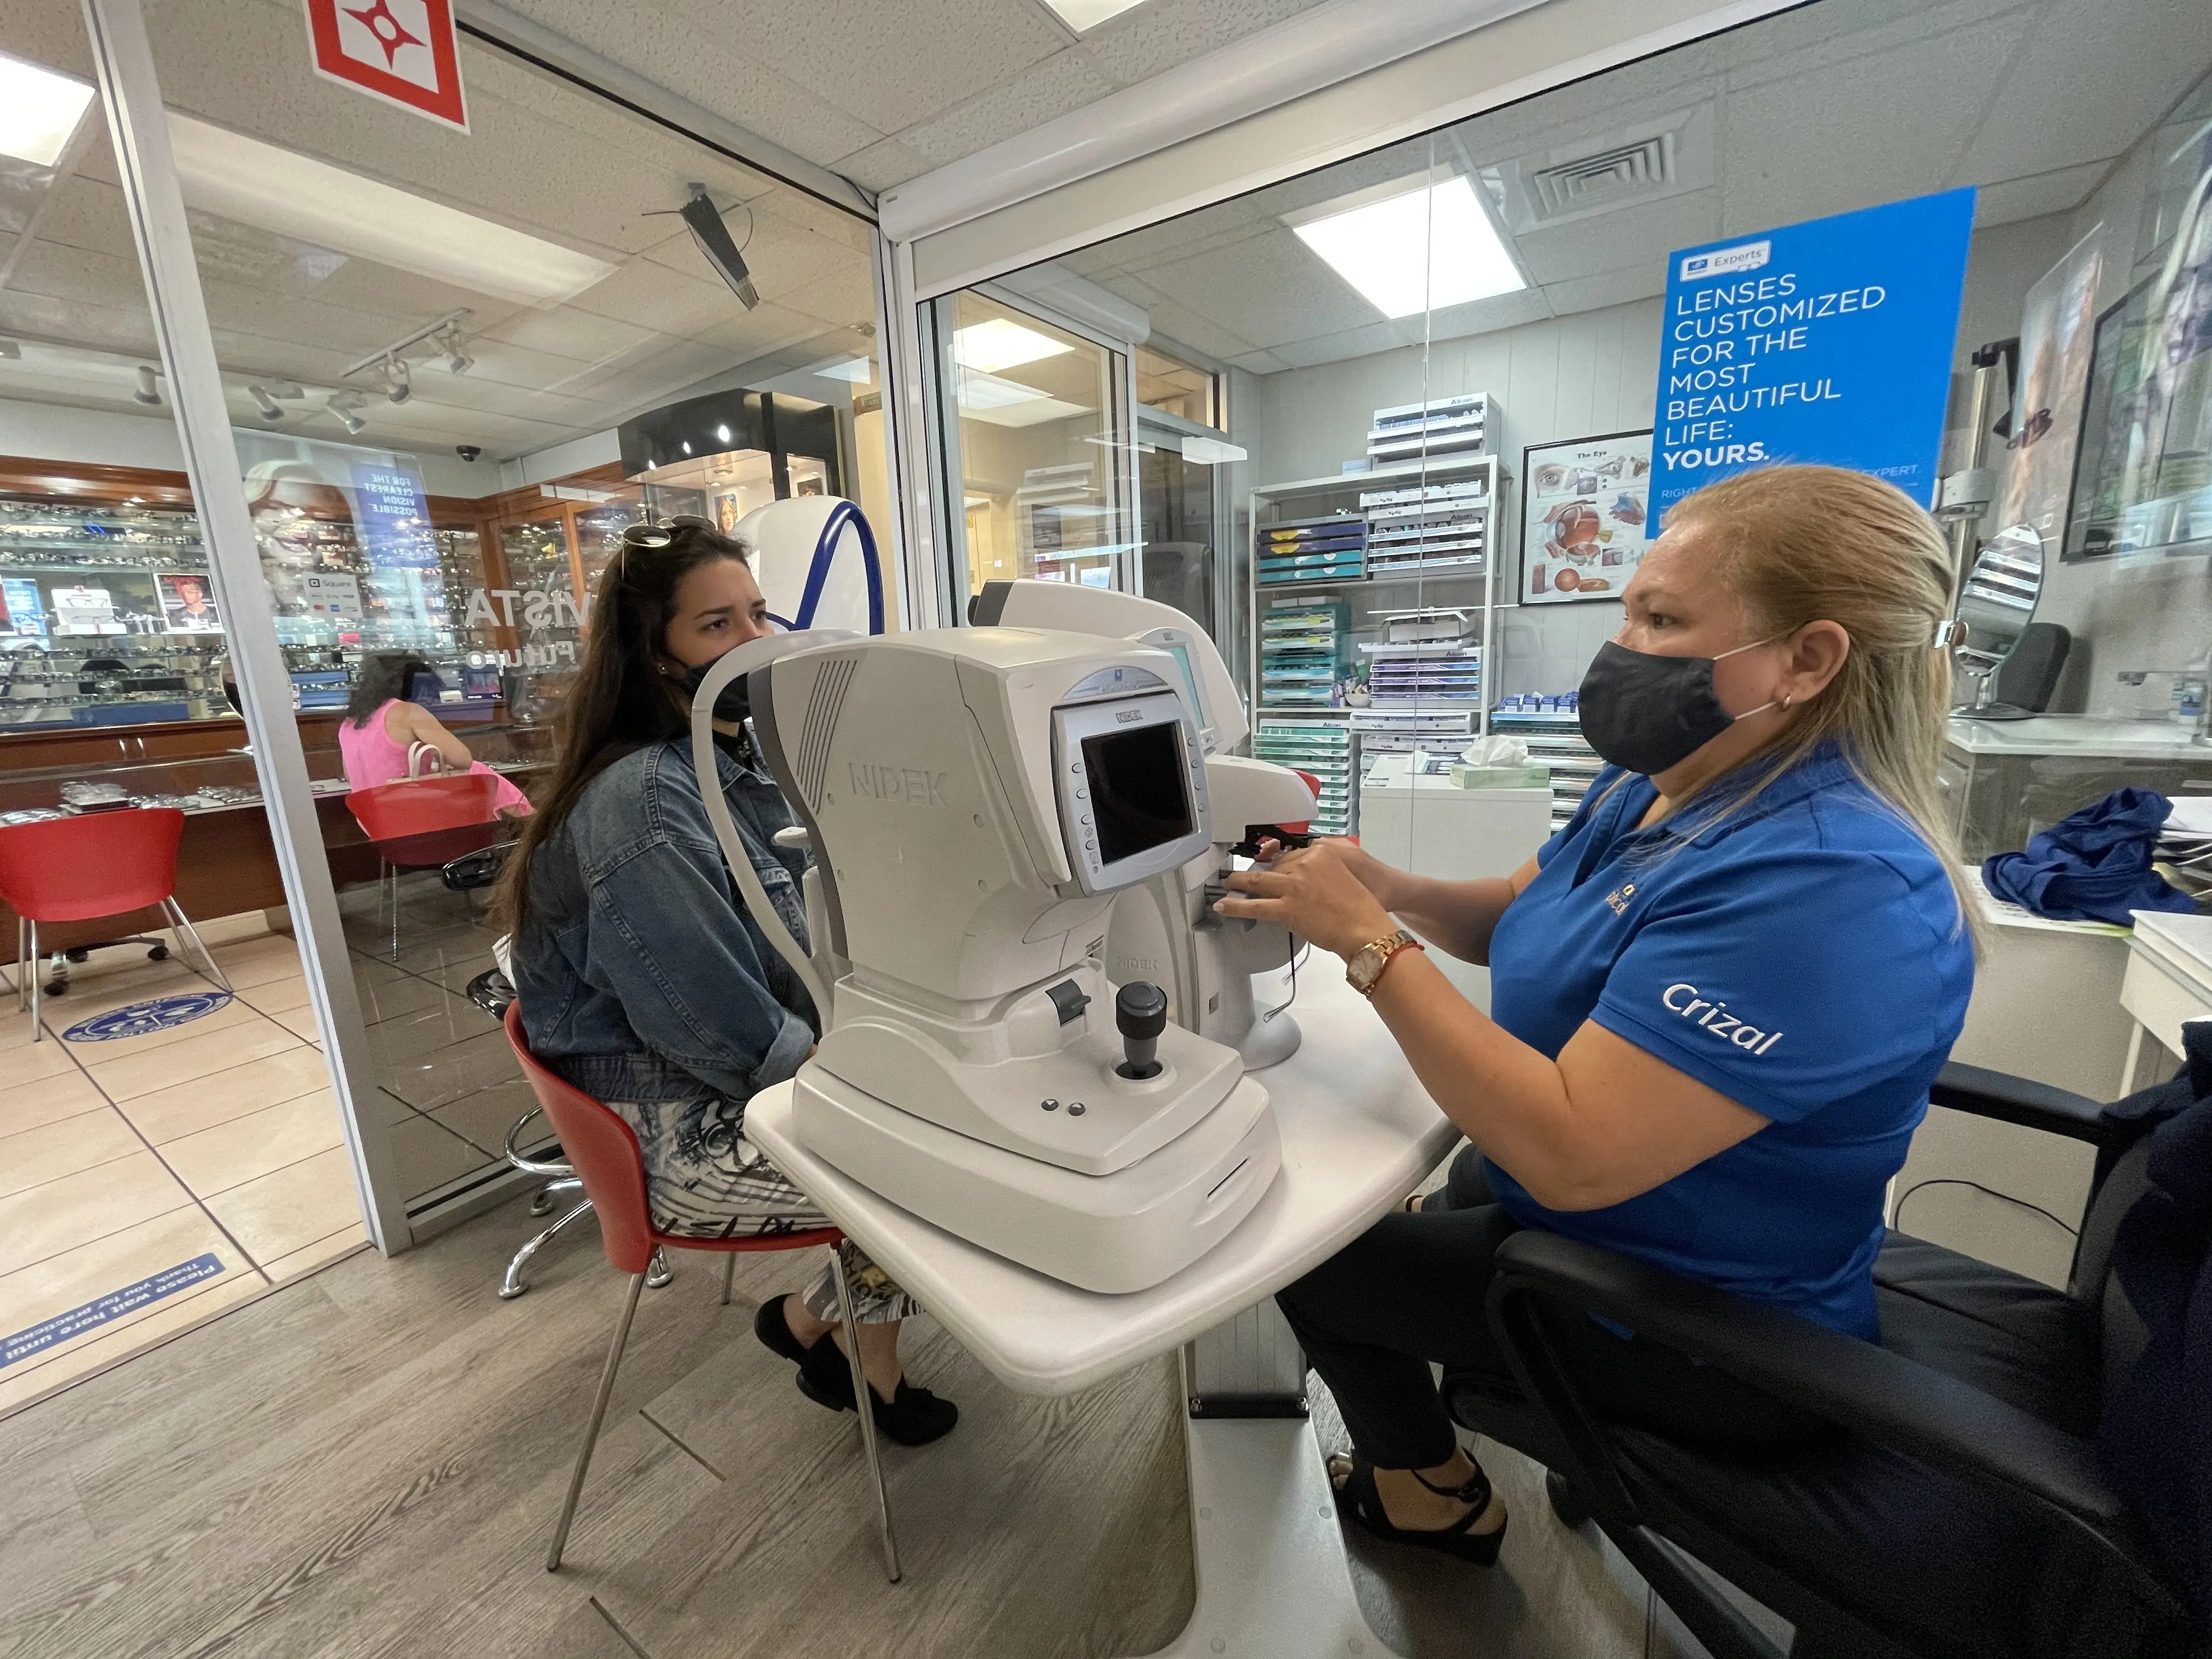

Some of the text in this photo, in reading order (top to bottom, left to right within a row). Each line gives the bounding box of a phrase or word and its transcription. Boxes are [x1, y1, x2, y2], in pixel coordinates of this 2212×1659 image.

[1714, 250, 1762, 267] Experts
[1677, 273, 1796, 315] LENSES
[1674, 286, 1886, 341] CUSTOMIZED
[1672, 327, 1808, 369] FOR THE
[1670, 363, 1755, 395] MOST
[1667, 379, 1841, 421] BEAUTIFUL
[1665, 422, 1733, 446] LIFE:
[1663, 442, 1769, 470] YOURS.
[1662, 487, 1697, 498] RIGHT
[323, 579, 352, 589] Square
[1115, 709, 1143, 724] NIDEK
[849, 763, 947, 808] NIDEK
[1663, 983, 1784, 1055] Crizal
[155, 1263, 200, 1283] Thank
[97, 1296, 120, 1310] for
[125, 1282, 152, 1296] you
[5, 1265, 216, 1359] Please wait here until
